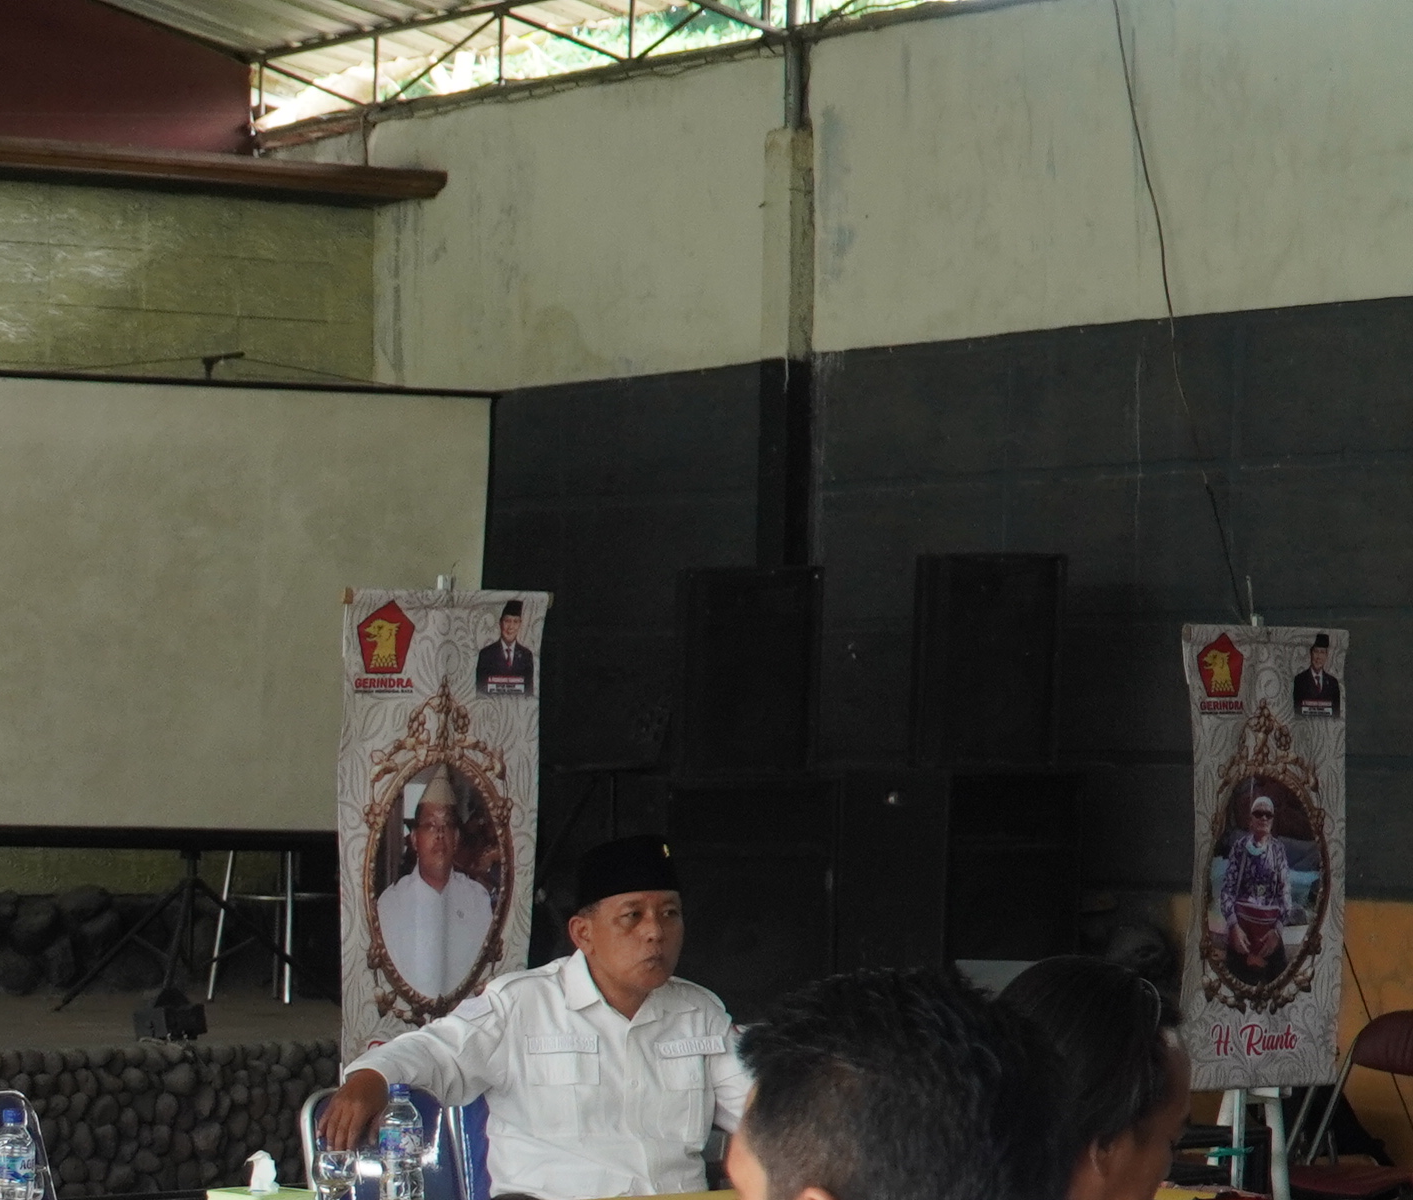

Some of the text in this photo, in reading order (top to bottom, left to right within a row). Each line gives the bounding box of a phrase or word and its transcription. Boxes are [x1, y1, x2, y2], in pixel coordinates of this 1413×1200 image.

[354, 677, 414, 688] GERINDRA
[1199, 700, 1244, 711] GERINDRA
[1210, 1021, 1300, 1057] H. Rianto
[659, 1038, 722, 1056] GERINDRA
